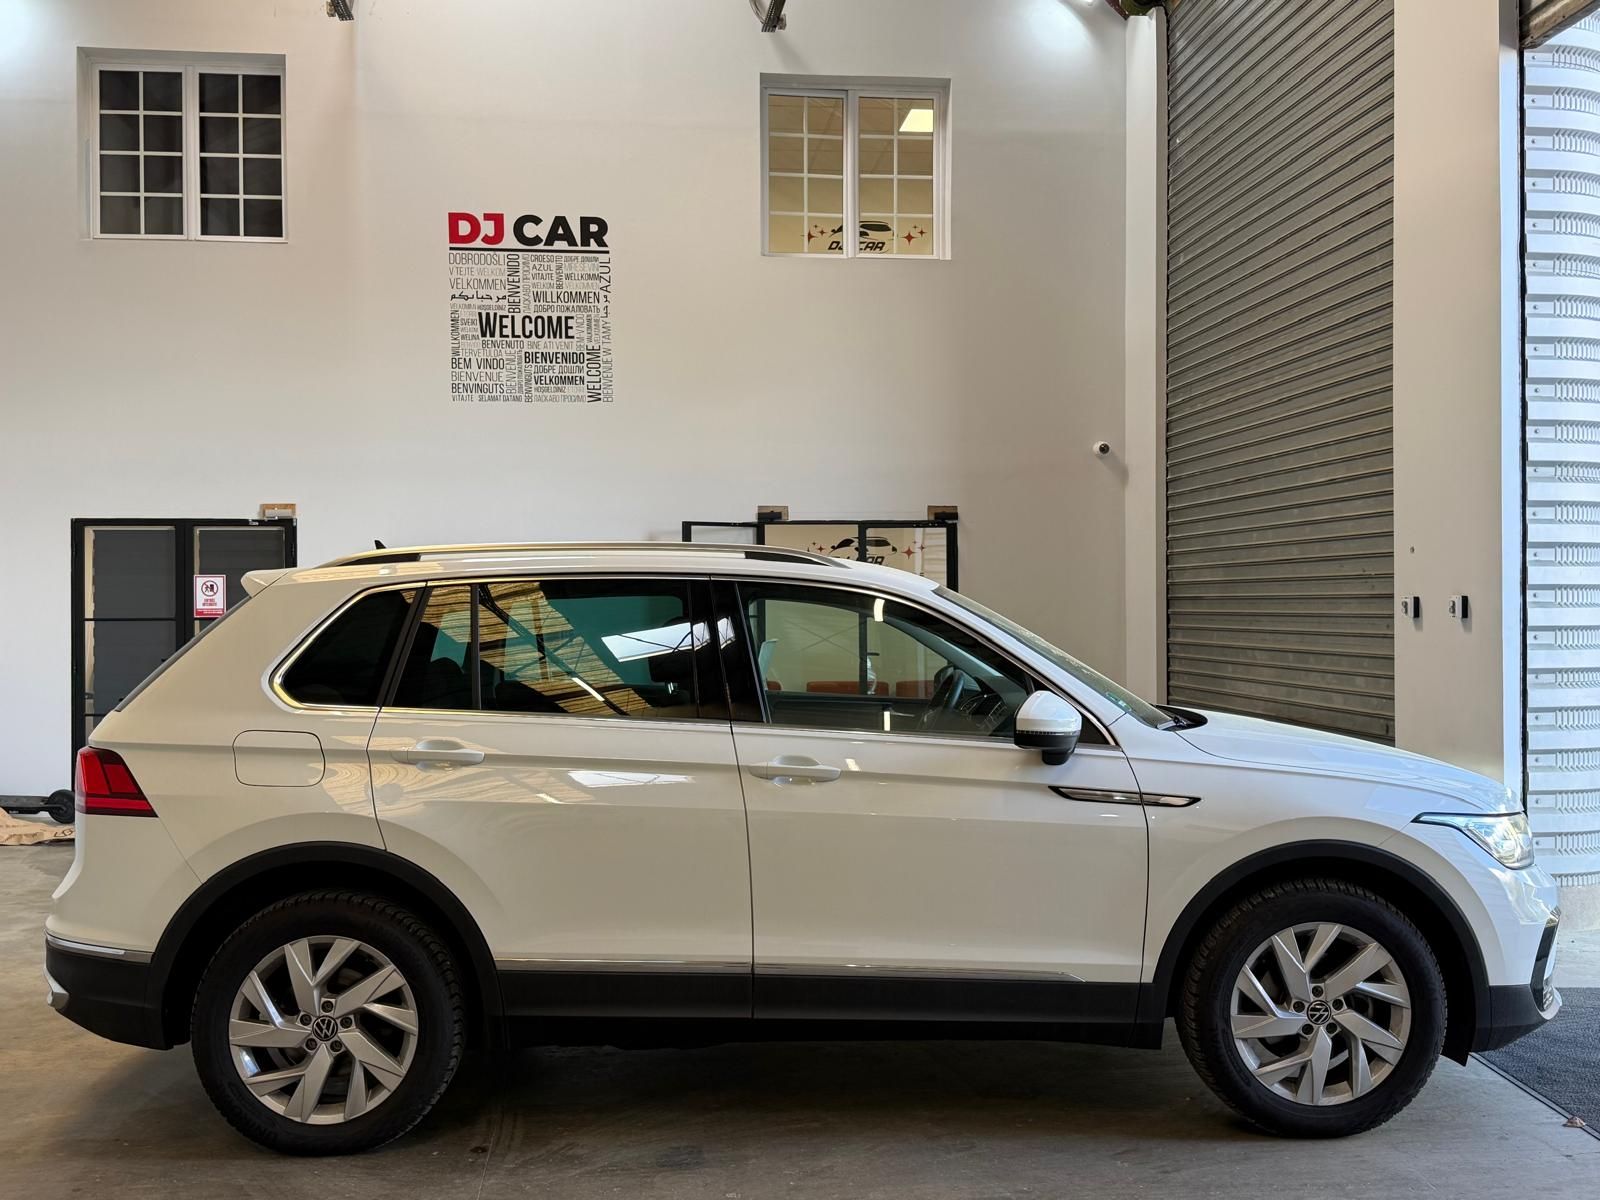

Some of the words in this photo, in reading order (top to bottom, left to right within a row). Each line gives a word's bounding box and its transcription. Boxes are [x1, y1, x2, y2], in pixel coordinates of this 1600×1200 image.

[448, 212, 504, 246] DJ
[513, 214, 609, 248] CAR
[531, 255, 555, 263] CROESO
[532, 264, 554, 272] AZUL
[556, 256, 564, 290] BENVENUTO
[532, 273, 554, 281] VITAJTE
[600, 257, 612, 293] AZUL
[450, 279, 507, 291] VELKOMMEN
[507, 254, 521, 314] BIENVENIDO
[533, 292, 600, 304] WILLKOMMEN
[479, 313, 575, 339] WELCOME
[482, 340, 525, 350] BENVENUTO
[452, 358, 472, 370] BEM
[477, 358, 505, 370] VINDO
[525, 352, 585, 365] BIENVENIDO
[506, 350, 517, 394] BIENVENUE
[534, 366, 556, 375] ДОБРЕ
[587, 346, 602, 403] WELCOME
[452, 372, 504, 383] BIENVENUE
[534, 376, 585, 386] VELKOMMEN
[452, 384, 505, 394] BENVINGUTS
